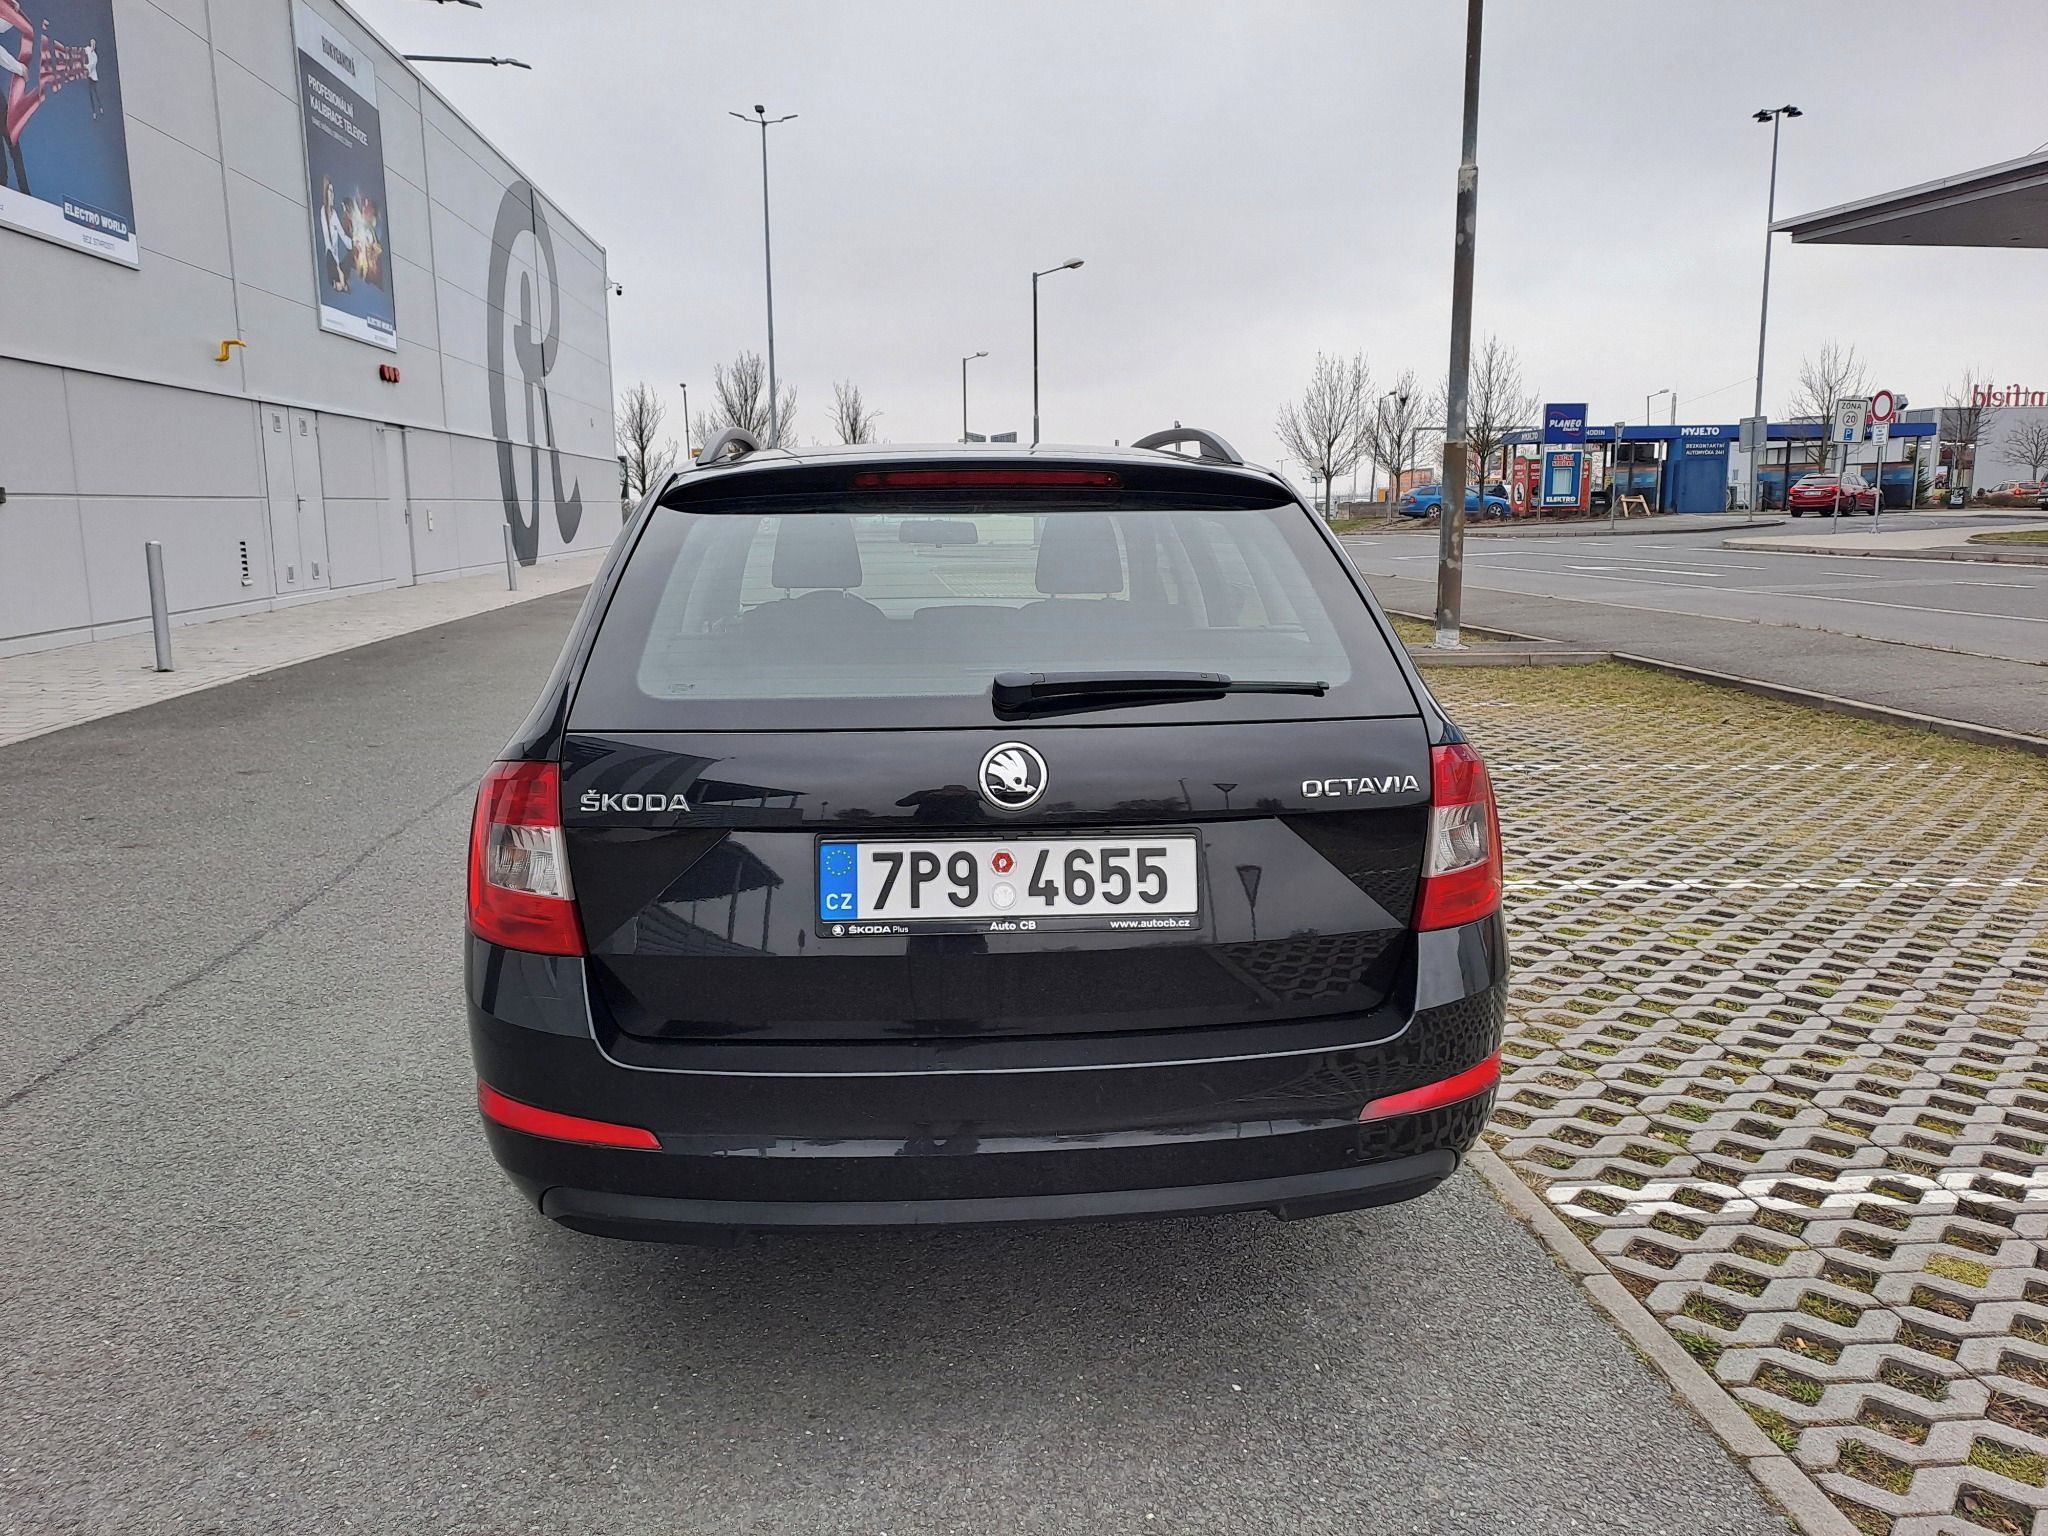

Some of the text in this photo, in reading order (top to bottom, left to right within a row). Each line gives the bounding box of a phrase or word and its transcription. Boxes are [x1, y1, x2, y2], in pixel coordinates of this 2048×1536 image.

[64, 202, 127, 235] ELECTRO WORLD
[1841, 402, 1862, 410] ZONA
[1549, 419, 1582, 428] PLANEO
[1845, 415, 1856, 424] 20
[1681, 427, 1720, 436] MYJE.TO
[1301, 775, 1420, 798] OCTAVIA
[580, 789, 691, 812] ŠKODA
[872, 847, 1168, 910] 7P9 4655
[825, 893, 853, 910] CZ
[848, 924, 909, 934] ŠKODA Plus
[990, 921, 1037, 932] Auto CB
[1109, 918, 1191, 929] www.autocb.cz
